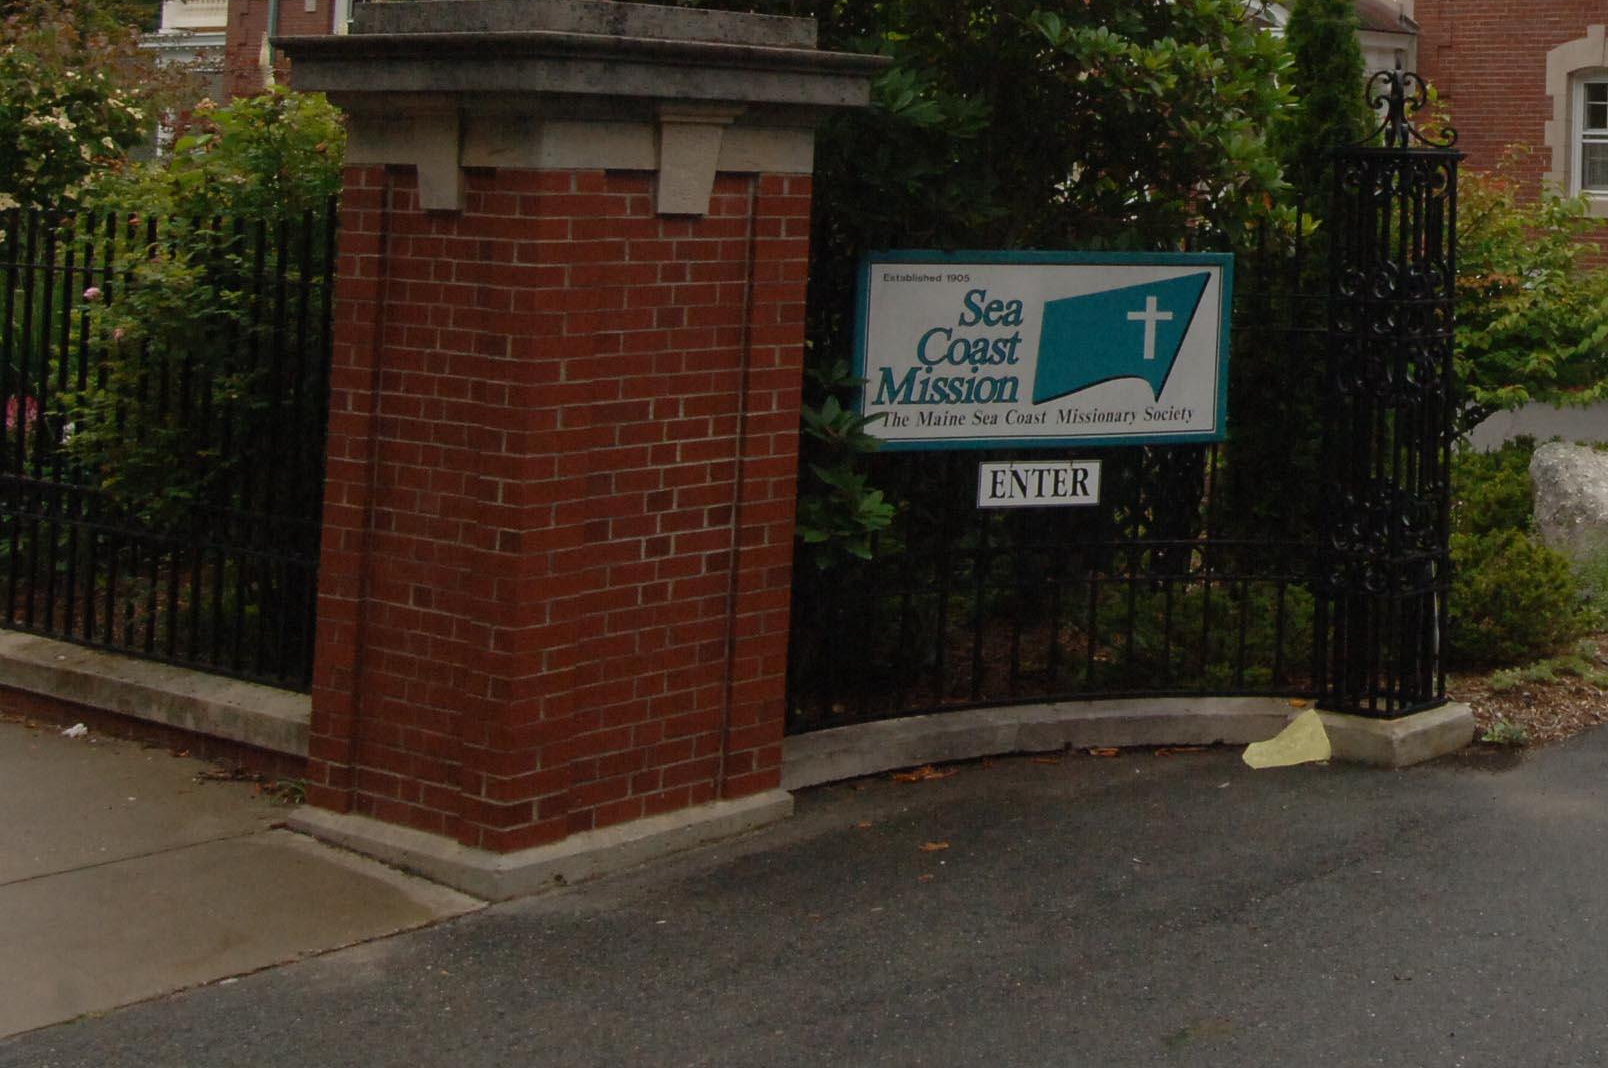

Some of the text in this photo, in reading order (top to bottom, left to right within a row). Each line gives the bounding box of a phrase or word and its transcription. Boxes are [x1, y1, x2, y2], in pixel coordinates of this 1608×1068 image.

[883, 273, 970, 282] Established 1905
[958, 288, 1024, 327] Sea
[917, 327, 1022, 366] Coast
[871, 366, 1020, 405] Mission
[882, 405, 1194, 427] The Maine Sea Coast Missionary Society
[988, 467, 1090, 499] ENTER
